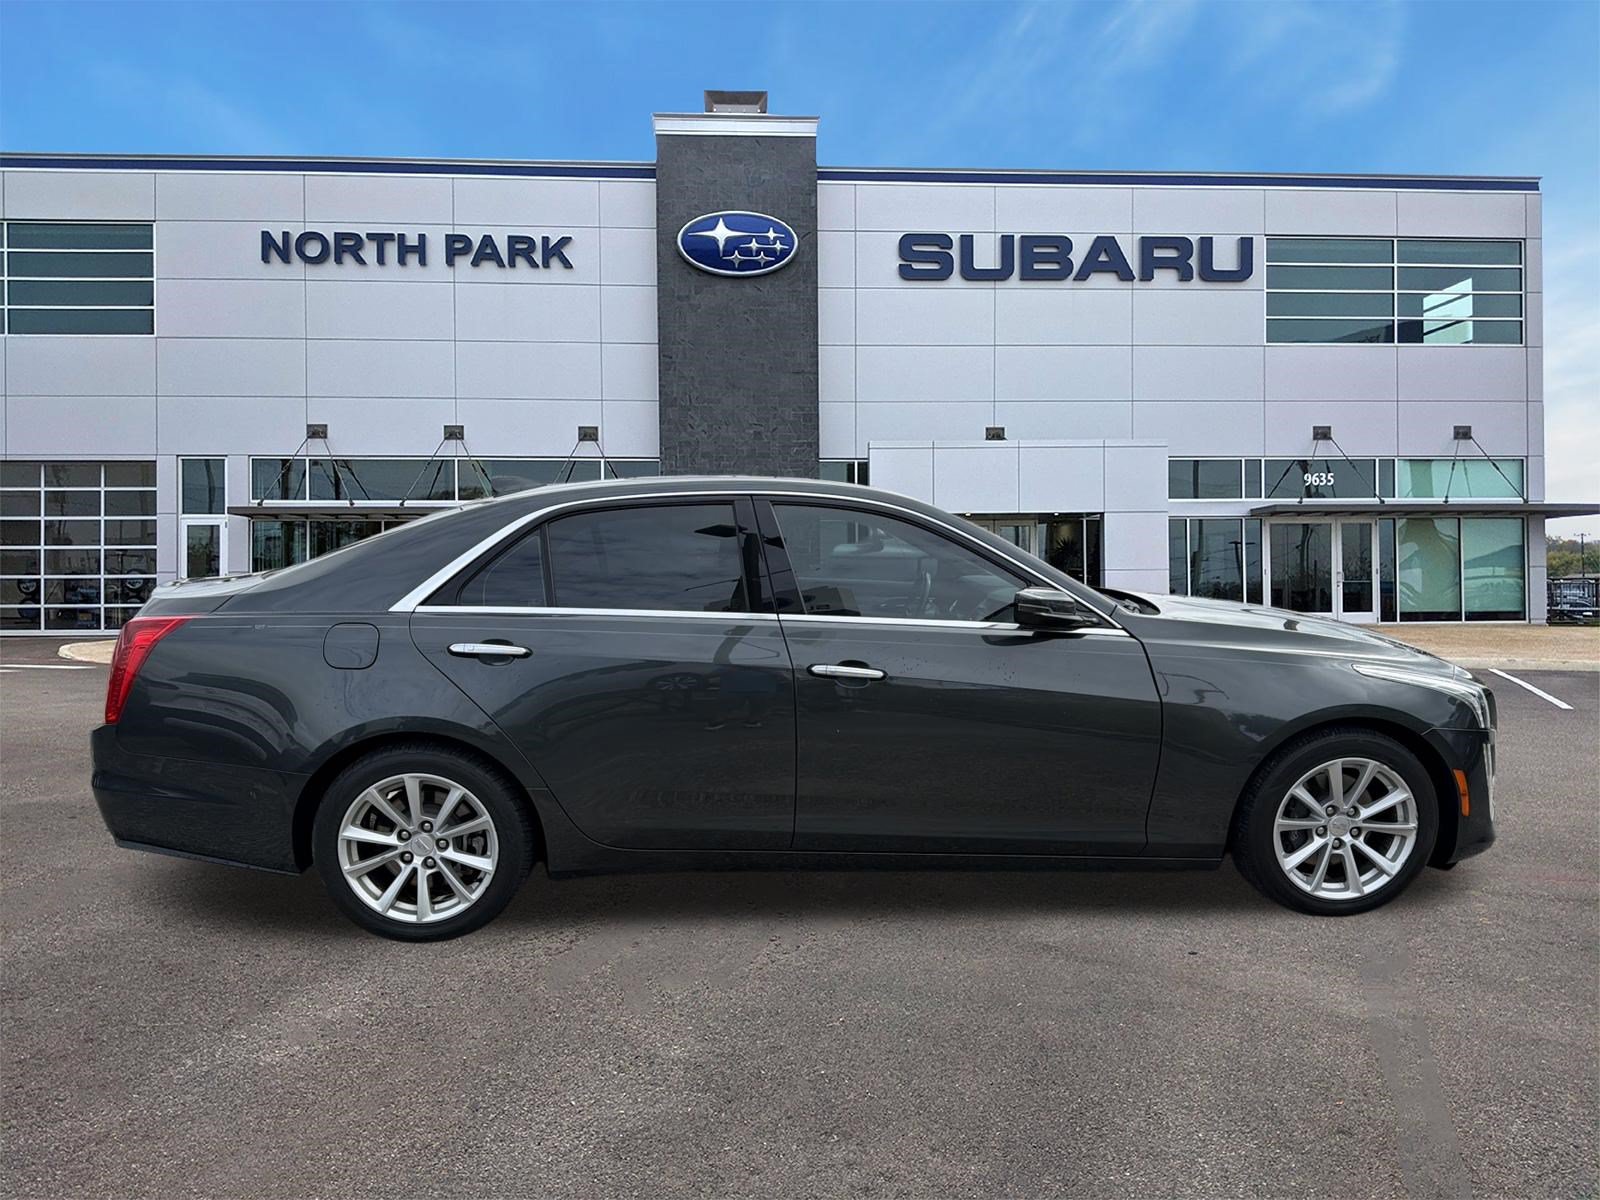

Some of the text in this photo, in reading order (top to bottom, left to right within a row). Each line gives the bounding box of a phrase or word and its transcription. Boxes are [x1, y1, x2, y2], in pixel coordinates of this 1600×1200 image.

[261, 230, 574, 270] NORTH PARK
[898, 233, 1254, 284] SUBARU
[1303, 472, 1335, 486] 9635
